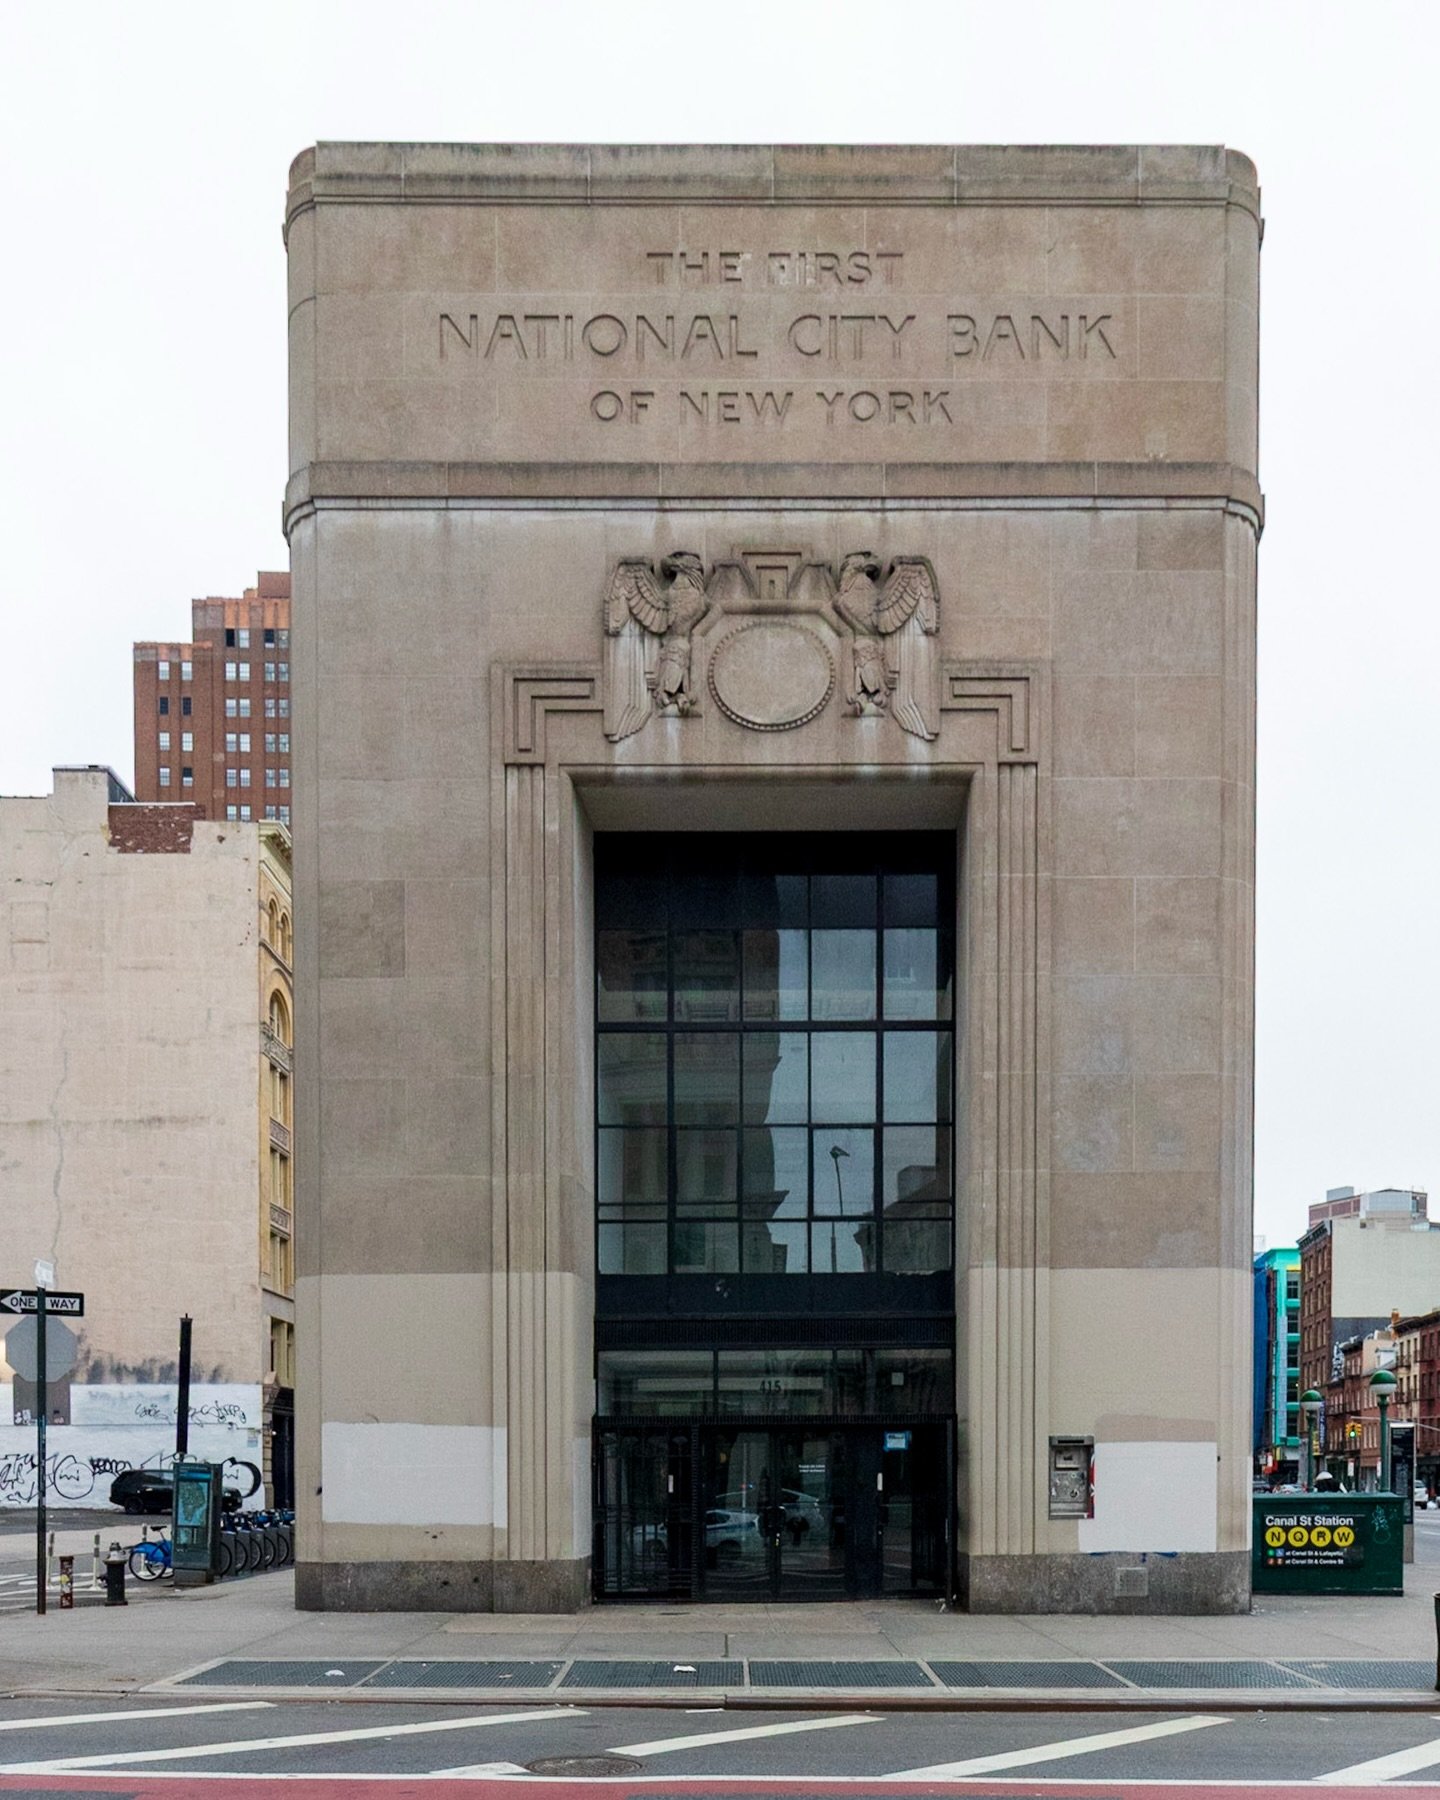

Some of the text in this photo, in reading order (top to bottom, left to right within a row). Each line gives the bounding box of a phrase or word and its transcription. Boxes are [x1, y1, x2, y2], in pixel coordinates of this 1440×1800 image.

[646, 252, 904, 285] THE FIRST
[438, 313, 1118, 361] NATIONAL CITY BANK
[590, 390, 954, 425] OF NEW YORK
[10, 1296, 77, 1309] ONE WAY
[1265, 1515, 1354, 1526] Canal St Station
